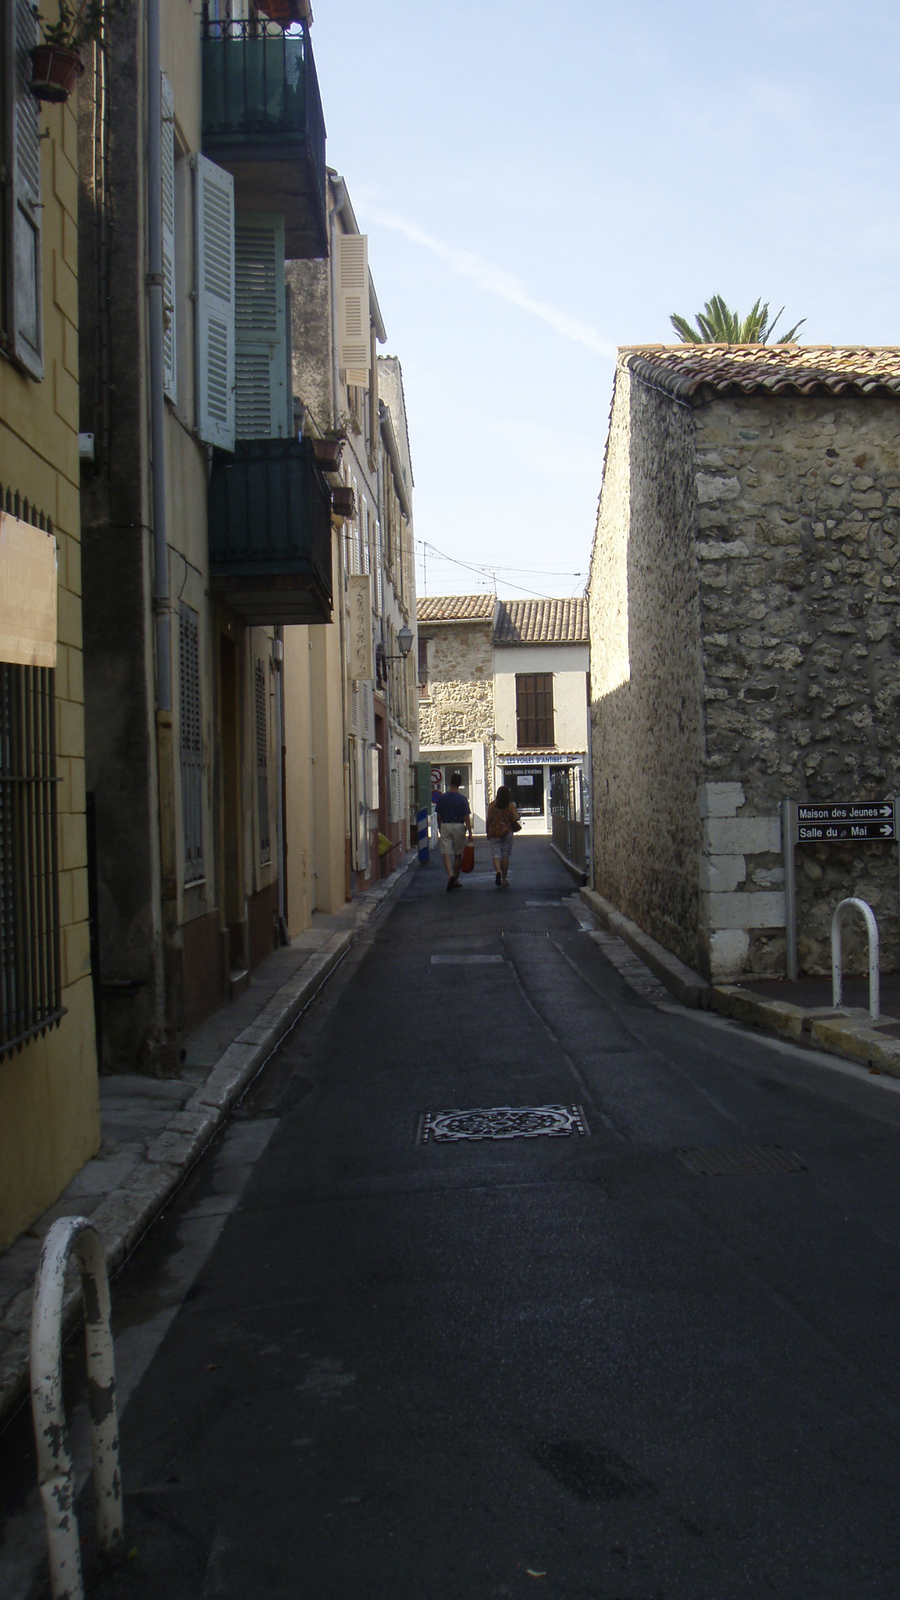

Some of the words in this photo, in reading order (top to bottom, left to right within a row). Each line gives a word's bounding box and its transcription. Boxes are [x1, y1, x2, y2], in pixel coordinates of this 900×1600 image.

[799, 809, 829, 818] Maison
[832, 808, 846, 817] des
[849, 807, 878, 817] Jeunes
[800, 828, 823, 838] Salle
[826, 827, 838, 837] du
[851, 826, 867, 836] Mai
